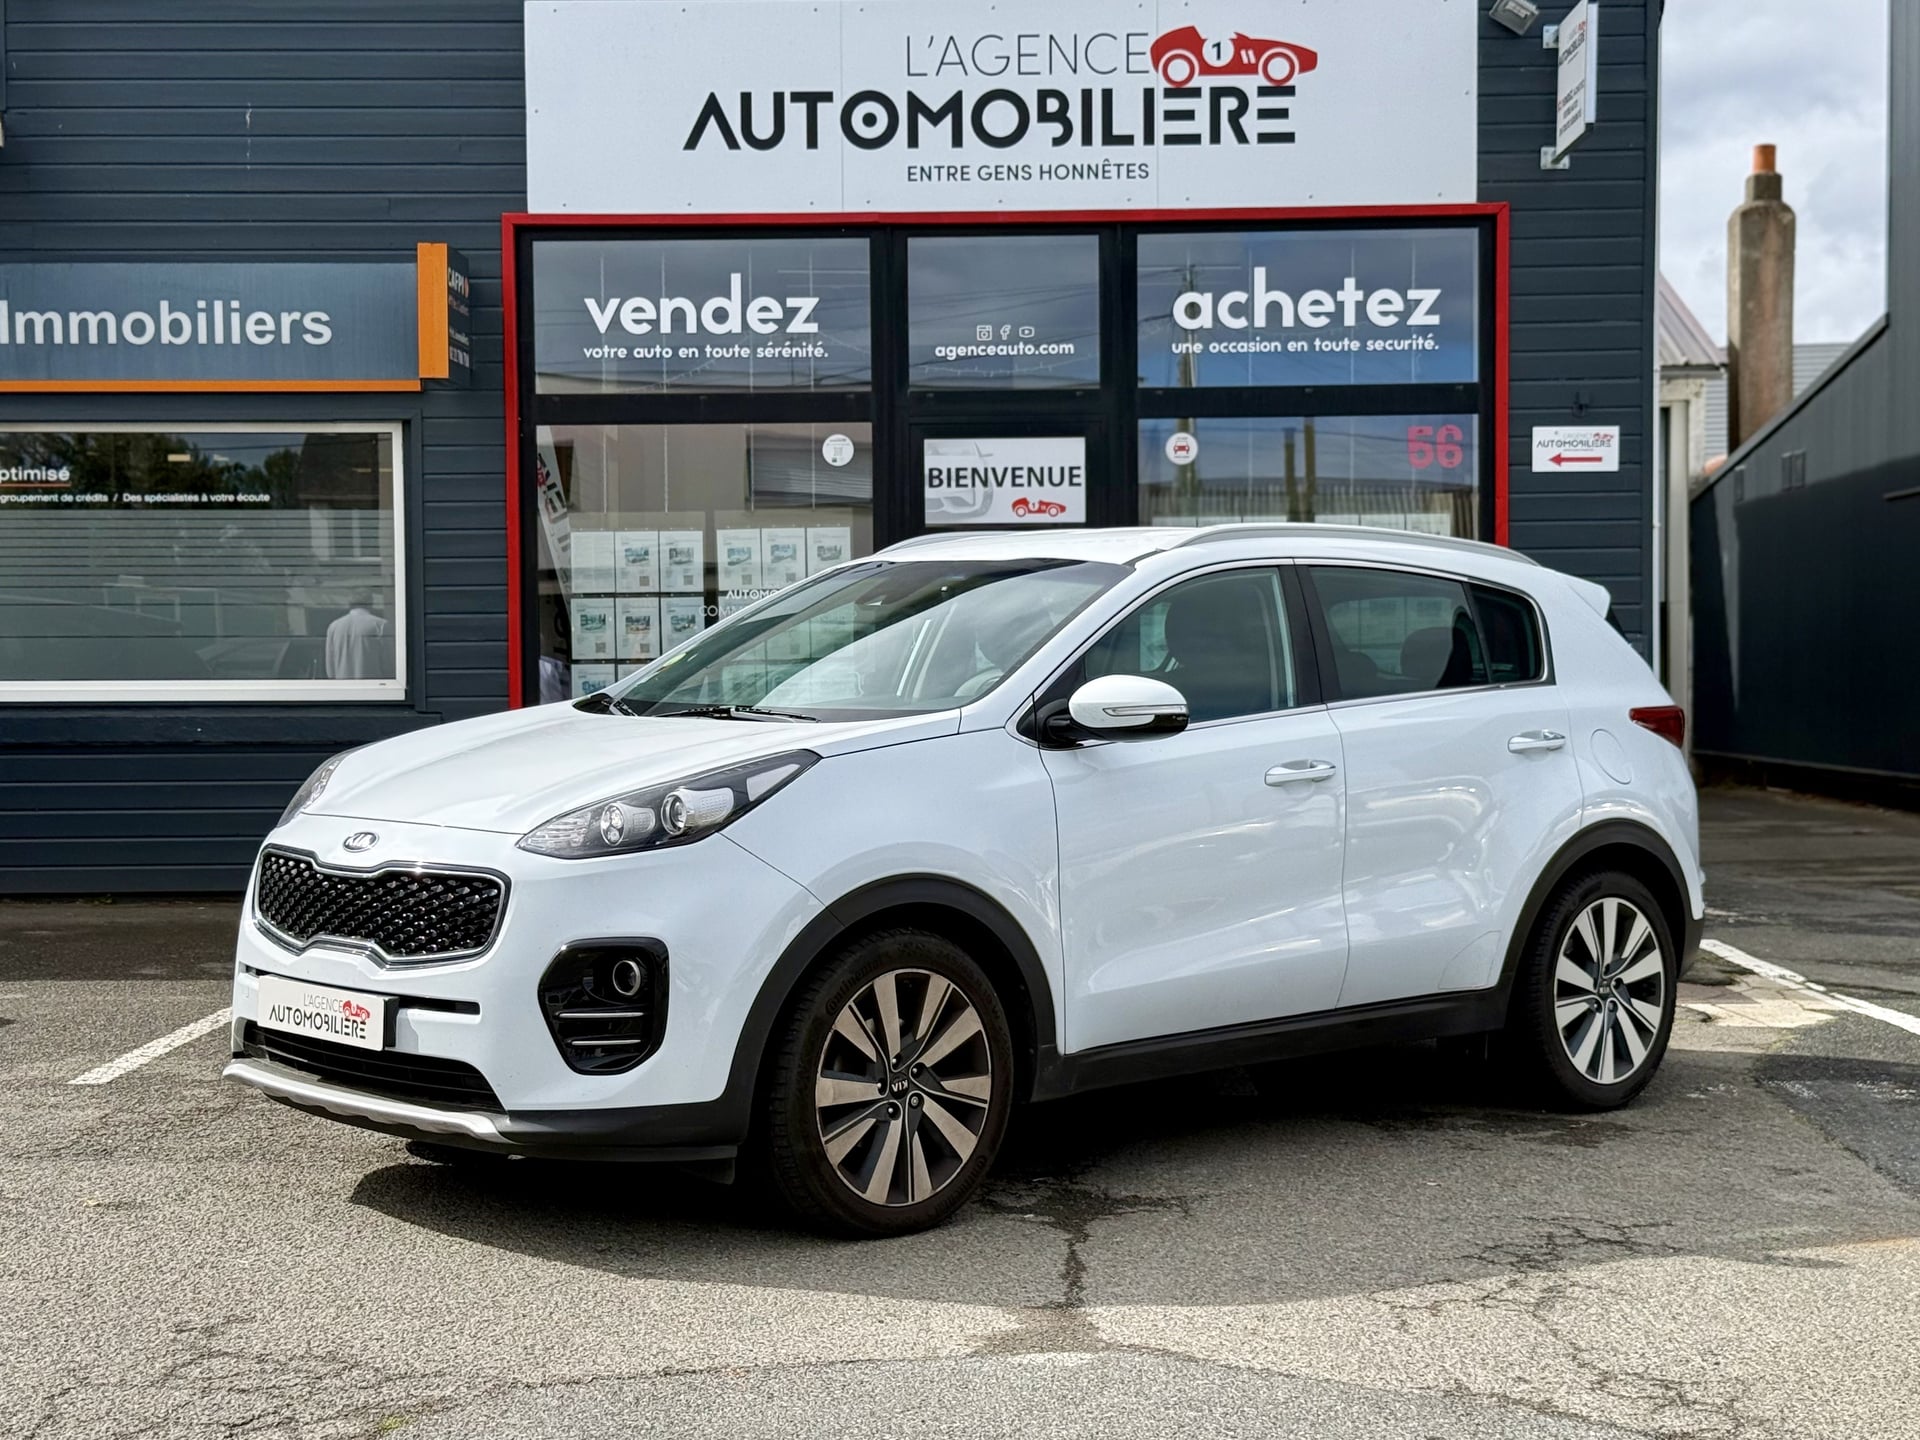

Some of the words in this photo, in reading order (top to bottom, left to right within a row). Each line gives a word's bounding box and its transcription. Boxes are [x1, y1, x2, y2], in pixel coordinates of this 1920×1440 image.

[906, 32, 1150, 77] L'AGENCE
[1211, 41, 1222, 61] 1
[682, 85, 1297, 151] AUTOMOBILIERE
[907, 165, 971, 182] ENTRE
[977, 164, 1033, 182] GENS
[1039, 158, 1149, 181] HONNÊTES
[583, 272, 820, 335] vendez
[1172, 266, 1442, 330] achetez
[583, 344, 628, 359] votre
[633, 344, 673, 359] auto
[678, 347, 699, 358] en
[704, 344, 751, 358] toute
[756, 340, 829, 358] sérénité.
[934, 341, 1075, 361] agenceauto.com
[1171, 341, 1203, 354] une
[1208, 336, 1282, 353] occasion
[1287, 340, 1308, 352] en
[1313, 337, 1361, 352] toute
[1366, 333, 1439, 351] securité.
[928, 466, 1083, 489] BIENVENUE
[60, 493, 74, 502] de
[75, 493, 109, 502] crédits
[122, 493, 142, 502] Des
[143, 493, 200, 504] spécialistes
[201, 493, 209, 502] à
[209, 493, 235, 502] votre
[236, 493, 271, 502] écoute
[303, 993, 344, 1014] L'AGENCE
[269, 1004, 367, 1040] AUTOMOBILIERE
